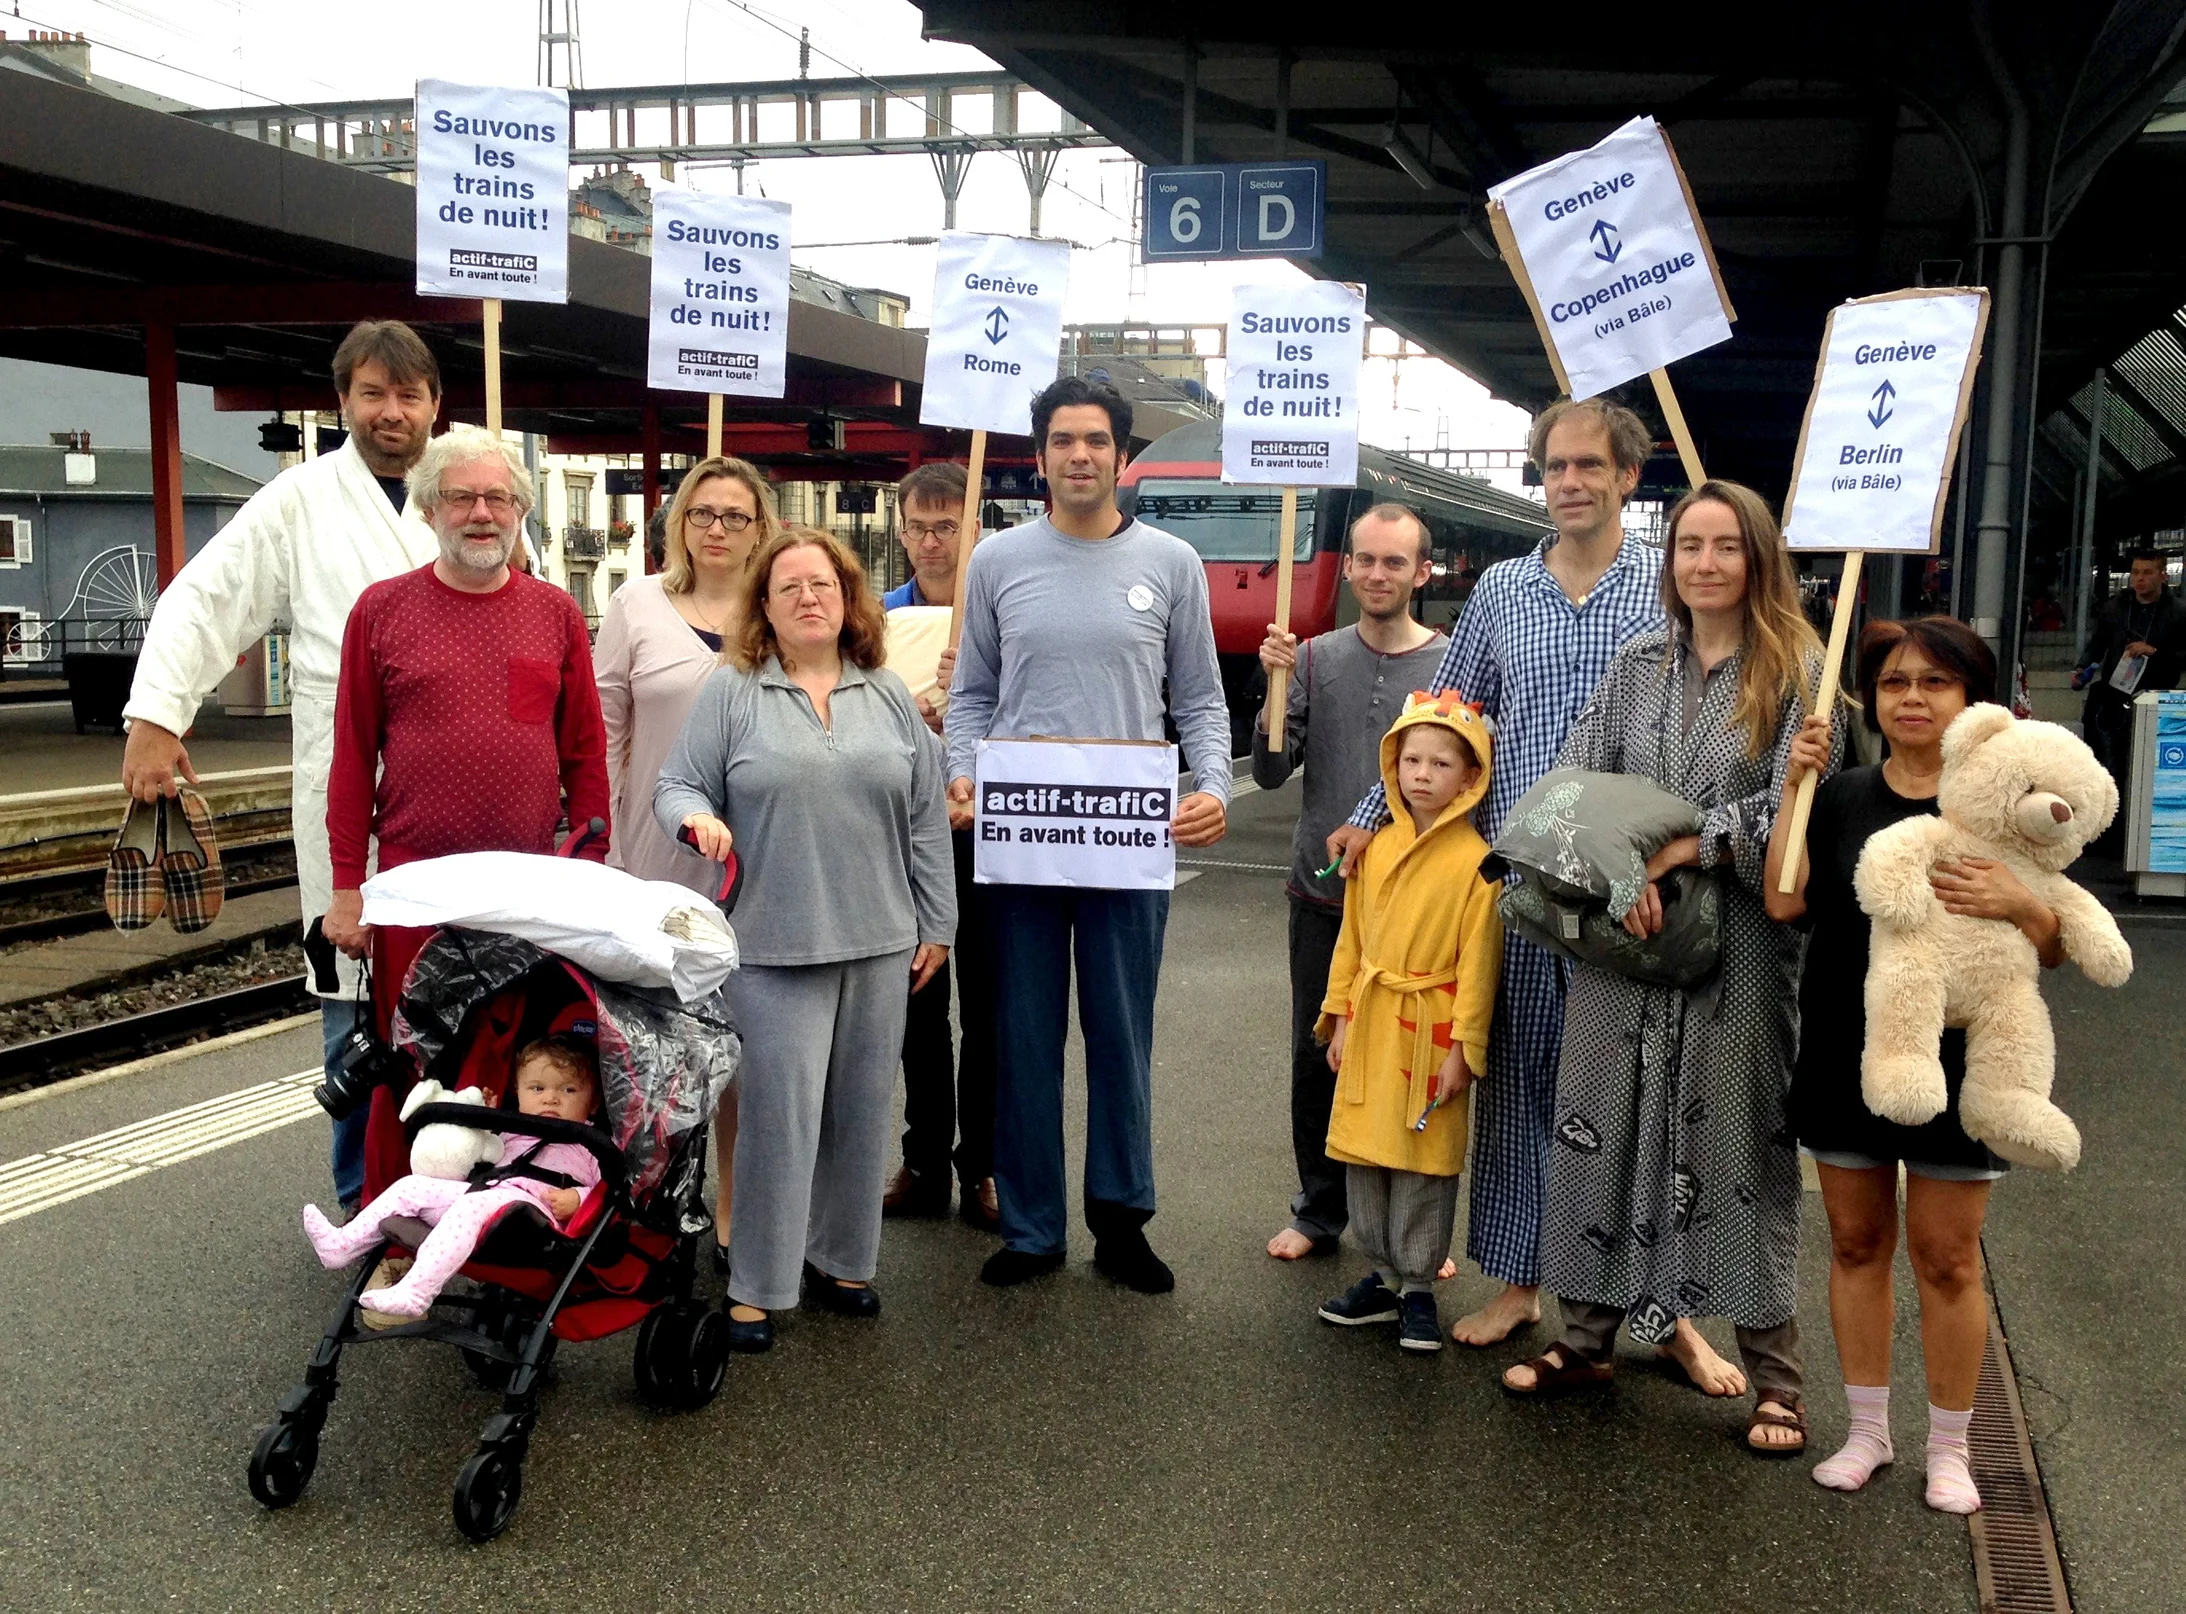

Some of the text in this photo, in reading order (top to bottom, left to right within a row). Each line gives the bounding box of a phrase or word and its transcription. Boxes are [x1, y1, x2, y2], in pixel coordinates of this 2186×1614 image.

[433, 110, 555, 143] Sauvons
[475, 143, 515, 169] les
[453, 172, 534, 200] trains
[1159, 184, 1178, 193] Voie
[1250, 180, 1284, 190] Secteur
[1544, 172, 1635, 221] Genève
[439, 200, 474, 224] de
[1170, 197, 1201, 243] 6
[1258, 195, 1295, 241] D
[667, 220, 779, 250] Sauvons
[452, 253, 534, 269] actif-trafiC
[705, 251, 741, 274] les
[449, 267, 537, 284] En avant toute !
[965, 273, 1038, 296] Genève
[684, 278, 758, 303] trains
[1551, 252, 1695, 323] Copenhague
[670, 304, 702, 325] de
[1241, 312, 1351, 333] Sauvons
[1595, 295, 1672, 339] (via Bâle)
[681, 352, 756, 367] actif-trafiC
[1277, 340, 1313, 361] les
[1855, 340, 1936, 365] Genève
[678, 365, 758, 381] En avant toute !
[964, 354, 1021, 376] Rome
[1257, 368, 1329, 389] trains
[1244, 396, 1274, 416] de
[1253, 443, 1326, 455] actif-trafiC
[1839, 444, 1903, 465] Berlin
[1251, 457, 1329, 469] En avant toute !
[1832, 473, 1901, 492] (via Bâle)
[842, 499, 850, 510] 8
[861, 499, 870, 510] C
[987, 789, 1165, 817] actif-trafiC
[982, 821, 1170, 848] En avant toute !
